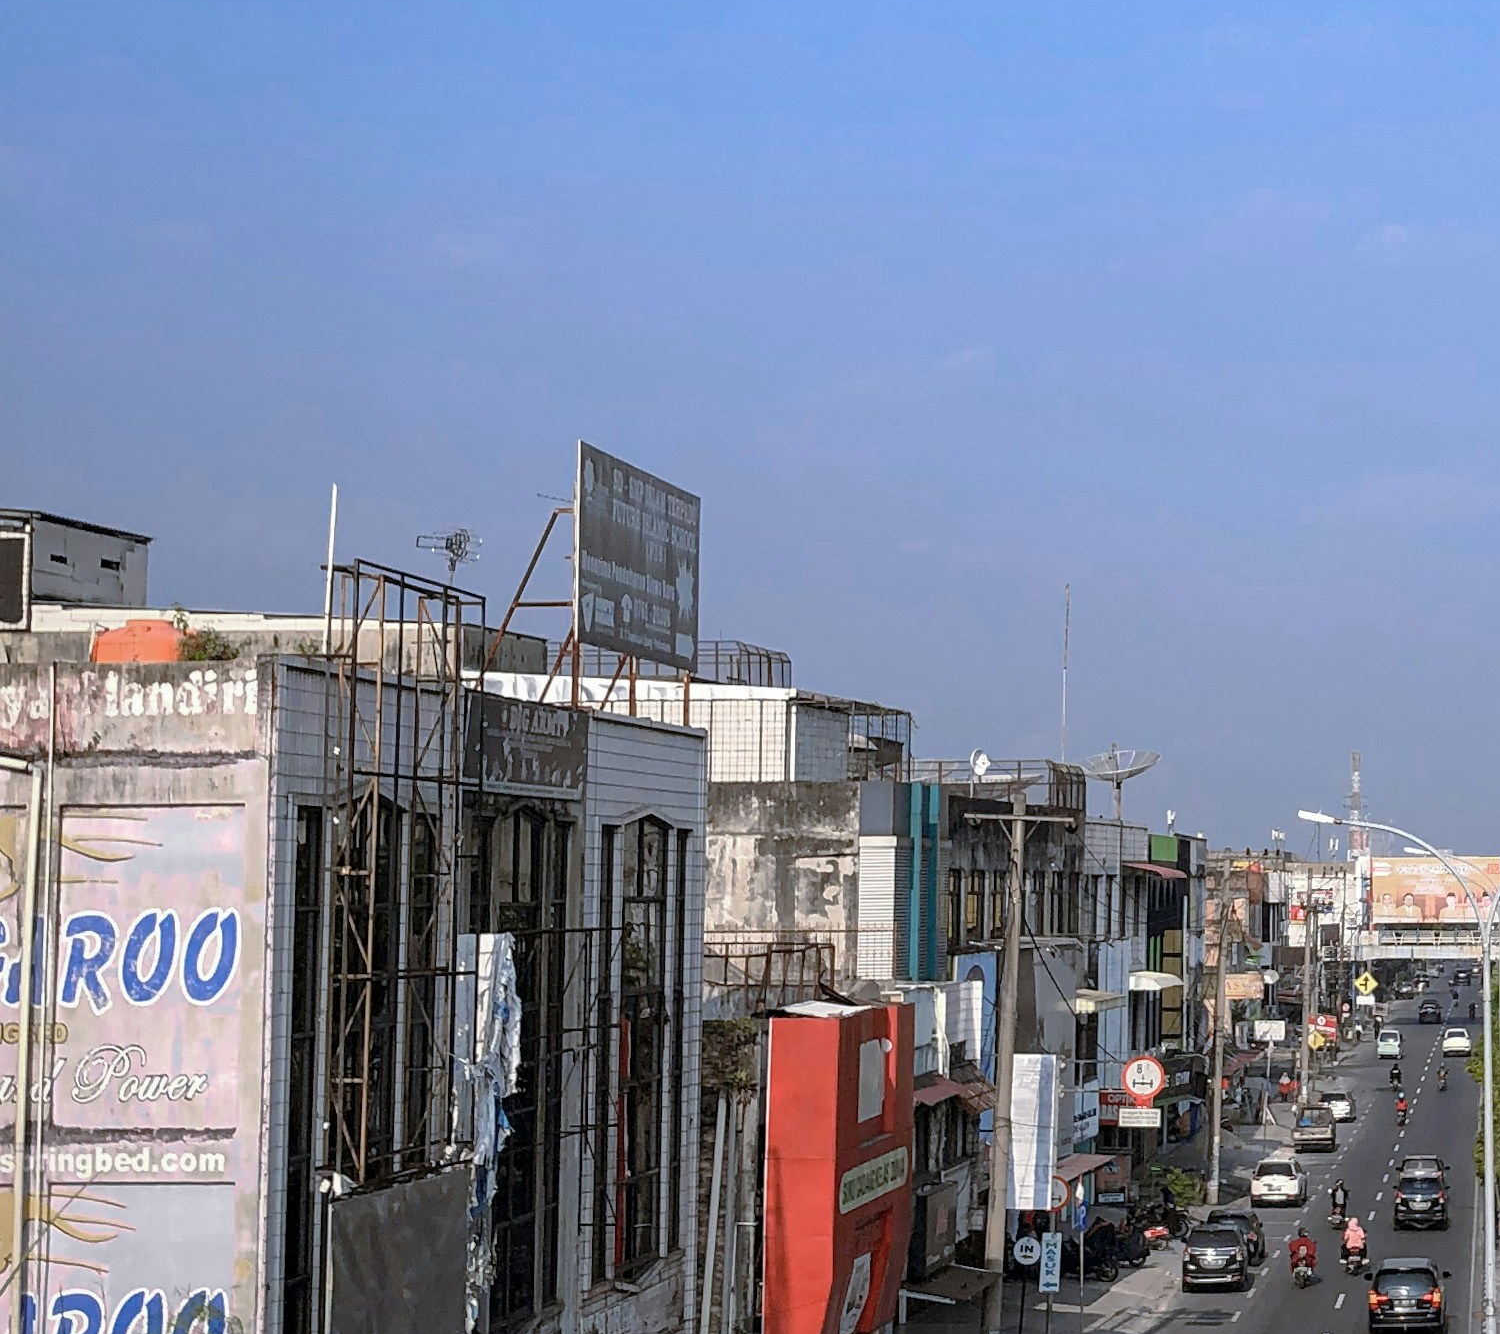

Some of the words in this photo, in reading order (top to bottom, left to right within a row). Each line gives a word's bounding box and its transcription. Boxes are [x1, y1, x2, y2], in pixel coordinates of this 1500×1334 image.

[71, 1043, 209, 1104] Power
[1020, 1245, 1034, 1254] IN
[1045, 1242, 1058, 1276] MASUK
